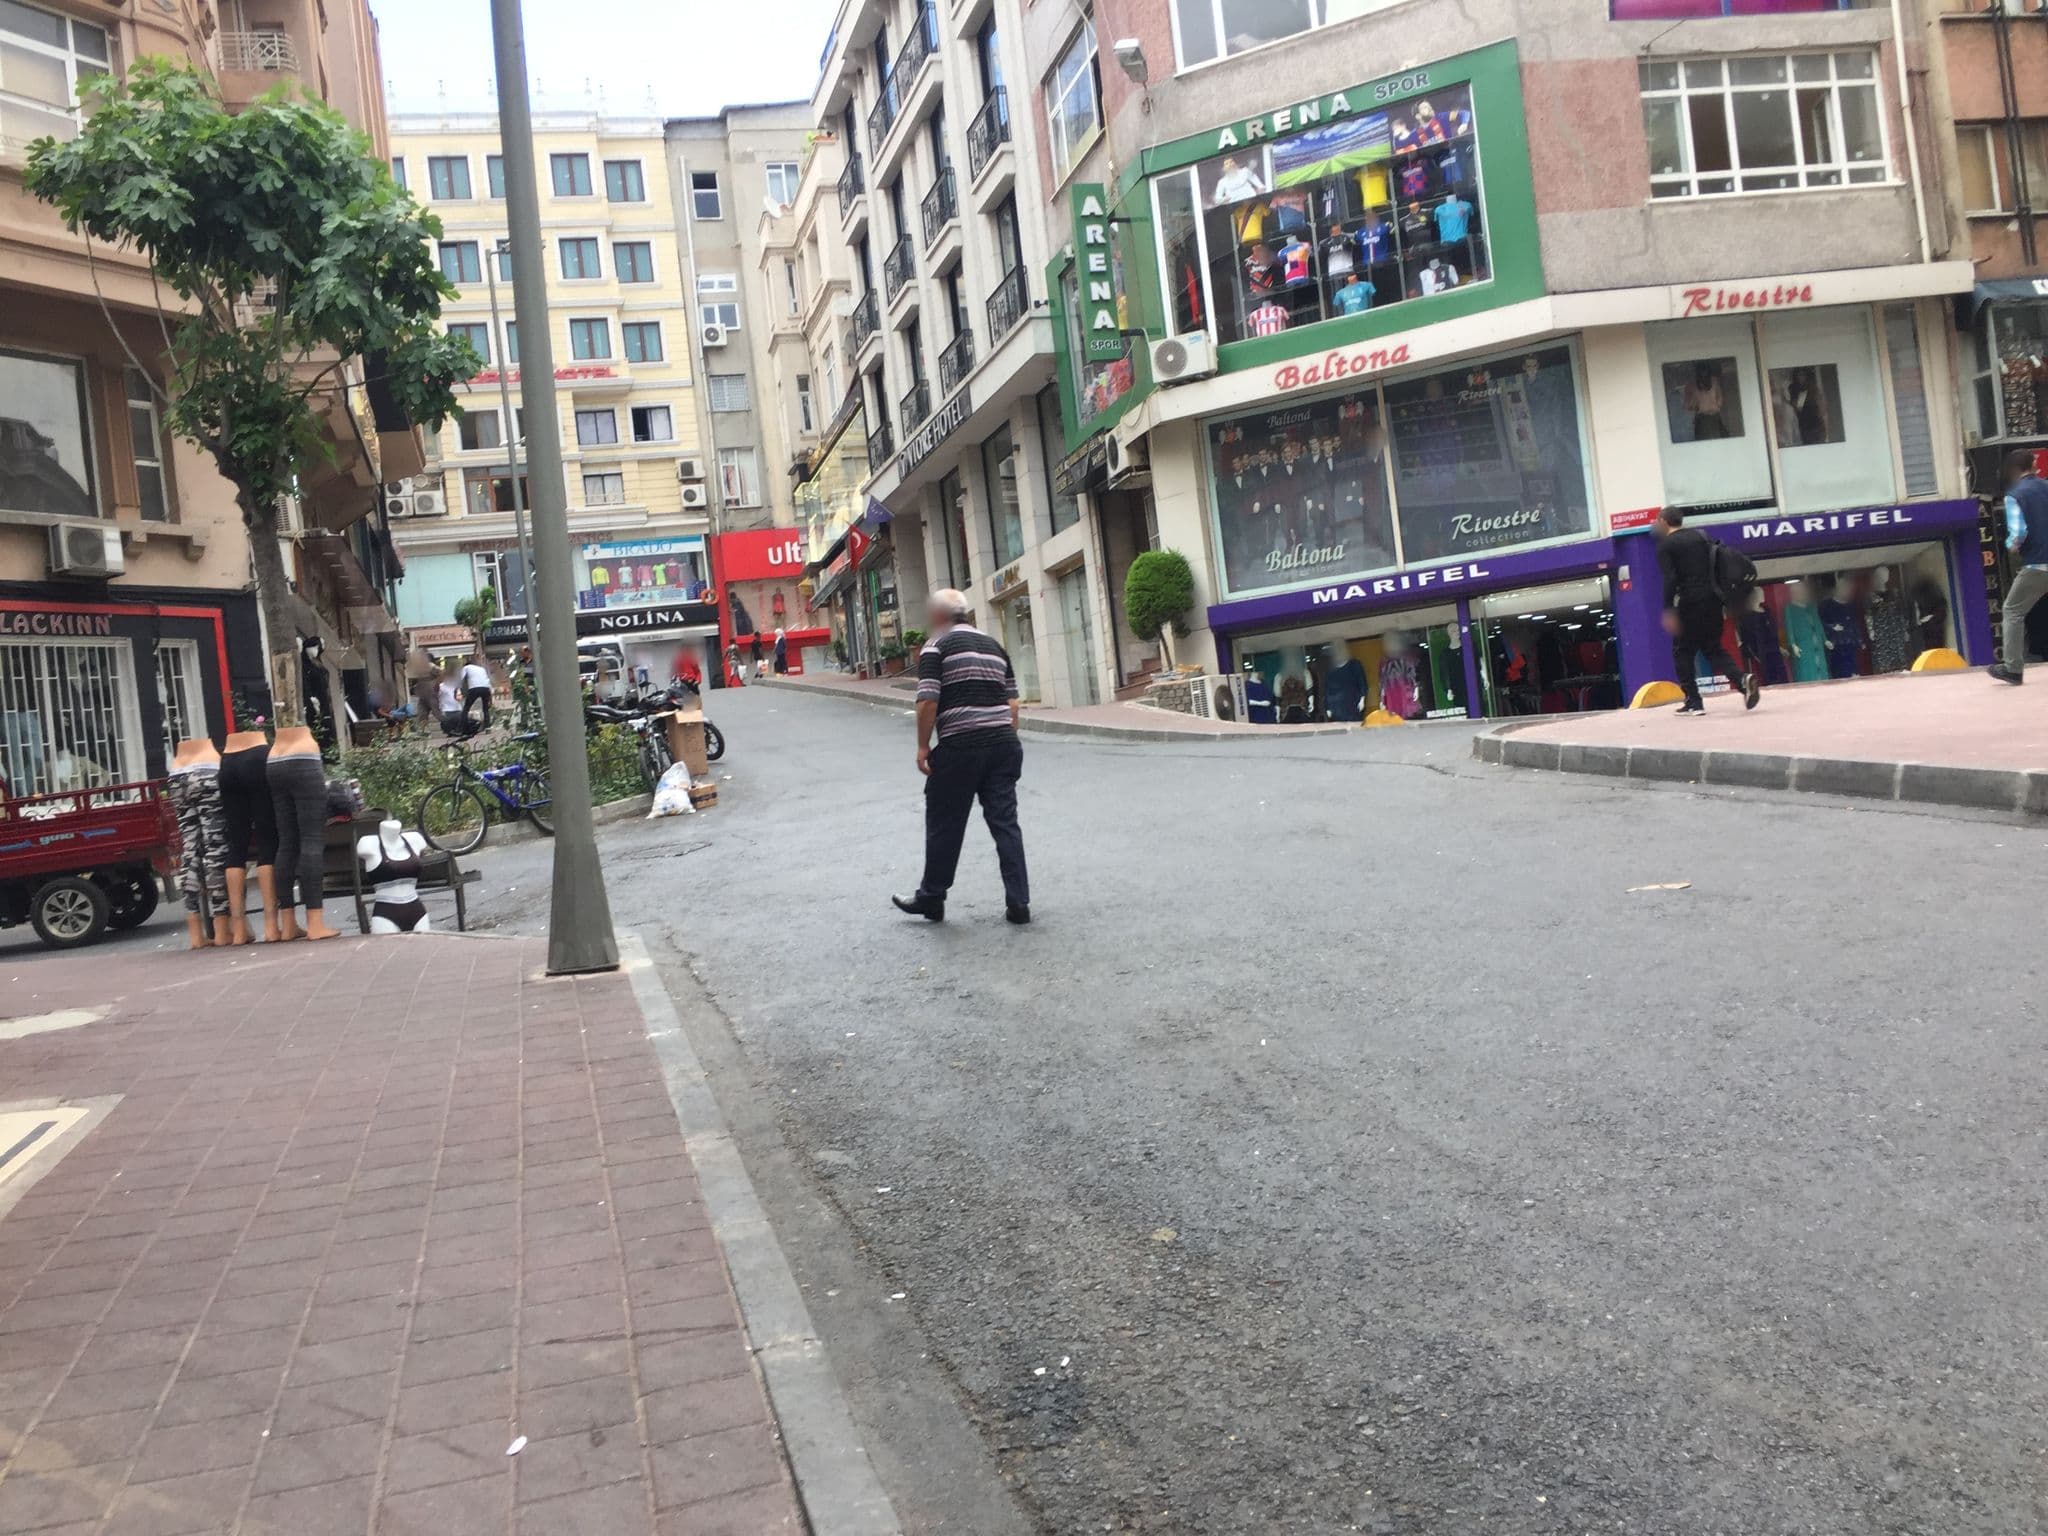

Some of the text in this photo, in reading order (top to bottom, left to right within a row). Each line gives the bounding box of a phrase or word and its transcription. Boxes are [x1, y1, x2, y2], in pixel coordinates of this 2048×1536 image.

[1217, 72, 1430, 151] ARENA SPOR
[1080, 195, 1116, 331] ARENA
[1682, 284, 1814, 318] Rivestre
[1090, 339, 1121, 351] SPOR
[1274, 343, 1411, 391] Baltona
[933, 397, 964, 446] HOTEL
[1465, 529, 1530, 549] collection
[1743, 510, 1912, 539] MARIFEL
[1265, 543, 1345, 572] Baltona
[1312, 564, 1490, 604] MARIFEL
[0, 612, 111, 635] LACKINN
[600, 610, 685, 629] NOLİNA
